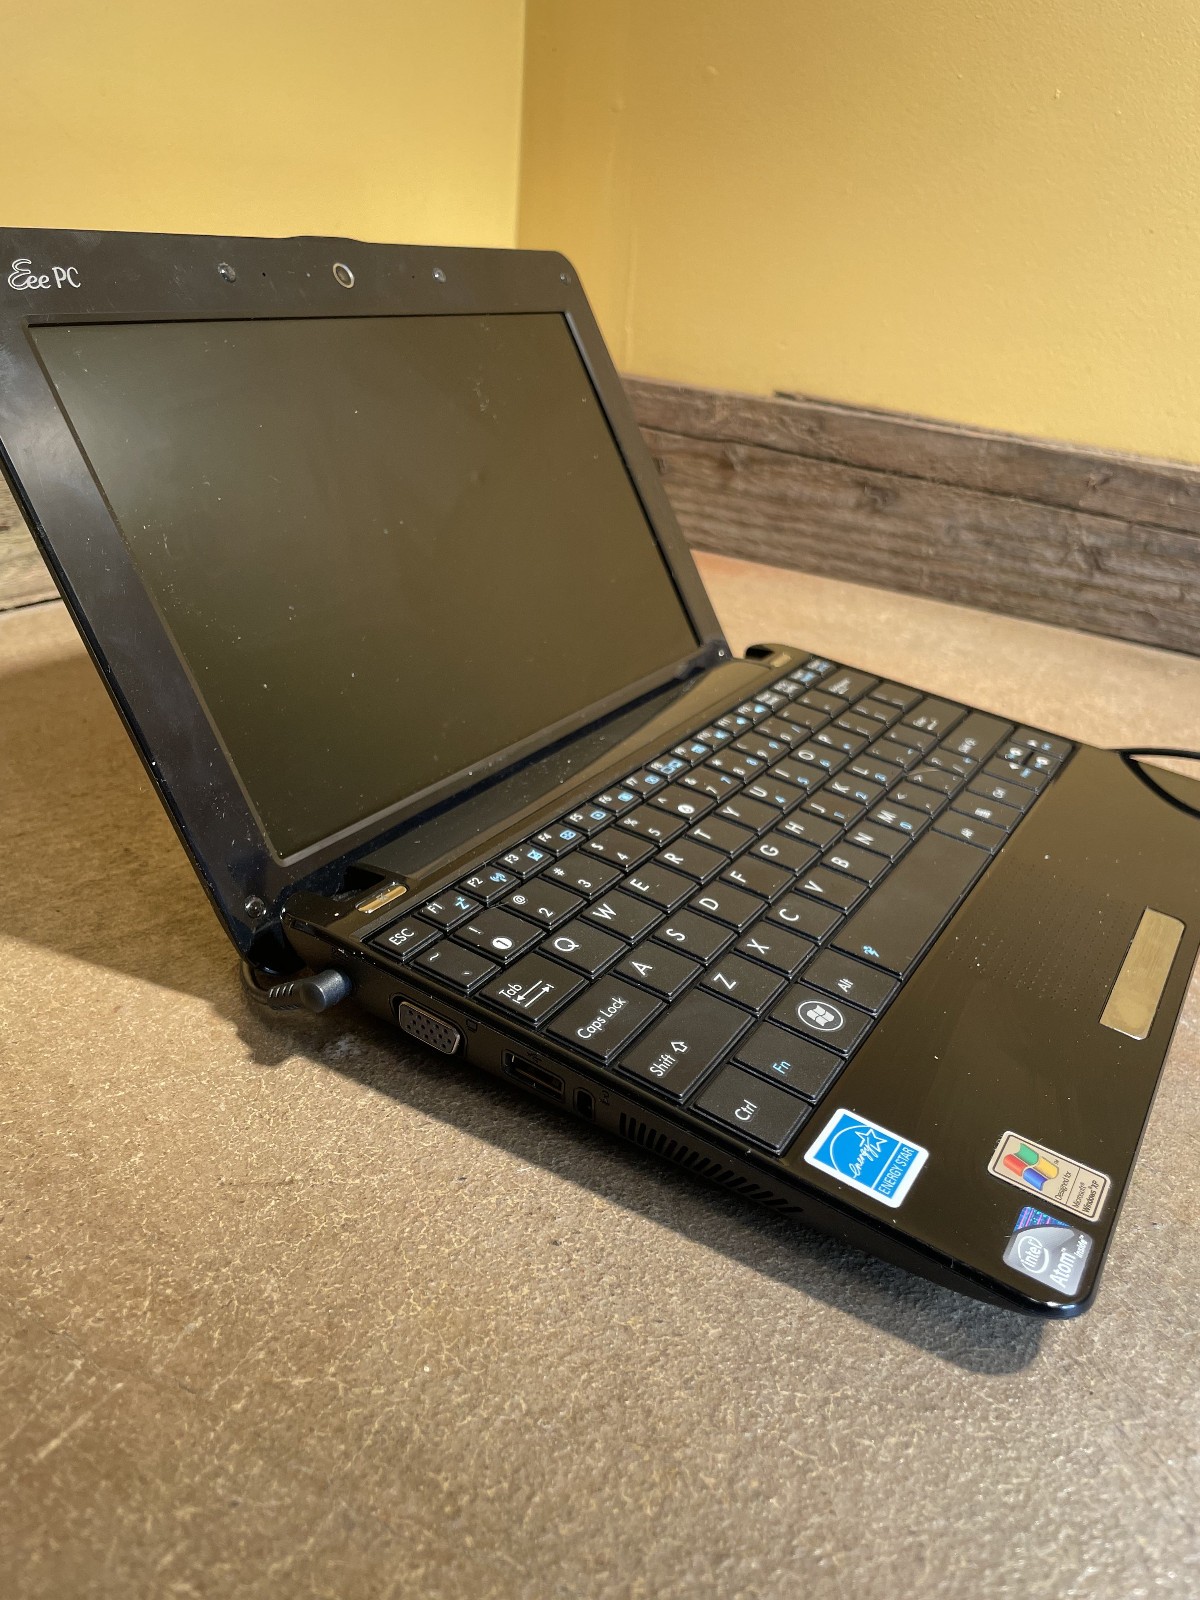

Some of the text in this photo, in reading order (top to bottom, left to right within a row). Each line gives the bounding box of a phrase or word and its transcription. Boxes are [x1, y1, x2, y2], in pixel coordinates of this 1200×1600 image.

[8, 258, 81, 290] Eee PC
[798, 751, 815, 760] O
[775, 768, 791, 777] I
[852, 766, 868, 775] L
[626, 777, 638, 786] F7
[832, 782, 850, 793] K
[706, 785, 718, 794] 7
[750, 786, 767, 797] U
[599, 795, 612, 804] F6
[723, 806, 740, 817] Y
[810, 803, 826, 813] J
[569, 813, 583, 822] F5
[624, 818, 639, 827] %
[877, 810, 897, 823] M
[648, 828, 661, 837] 5
[785, 821, 805, 834] H
[538, 833, 552, 843] F4
[694, 829, 711, 840] T
[854, 832, 874, 845] N
[617, 852, 628, 861] 4
[760, 844, 779, 857] G
[504, 854, 520, 864] F3
[664, 852, 684, 865] R
[831, 856, 849, 869] B
[553, 868, 566, 876] #
[730, 870, 747, 883] F
[467, 877, 483, 888] F2
[578, 879, 592, 888] 3
[630, 879, 649, 892] E
[804, 880, 824, 893] V
[512, 894, 527, 905] @
[699, 897, 719, 911] D
[427, 902, 443, 914] F1
[538, 907, 554, 917] 2
[592, 903, 617, 920] W
[779, 909, 799, 922] C
[389, 928, 415, 946] ESC
[666, 928, 686, 941] S
[554, 937, 579, 952] Q
[747, 939, 769, 954] X
[632, 961, 653, 976] A
[714, 972, 736, 990] Z
[837, 978, 854, 993] Alt
[499, 983, 522, 999] Tab
[577, 996, 626, 1039] Caps Lock
[649, 1053, 676, 1077] Shift
[772, 1060, 791, 1075] Fn
[734, 1099, 758, 1121] Ctrl
[878, 1147, 915, 1195] ENERGY STAR
[1055, 1177, 1069, 1200] Designed
[1091, 1180, 1099, 1190] XP
